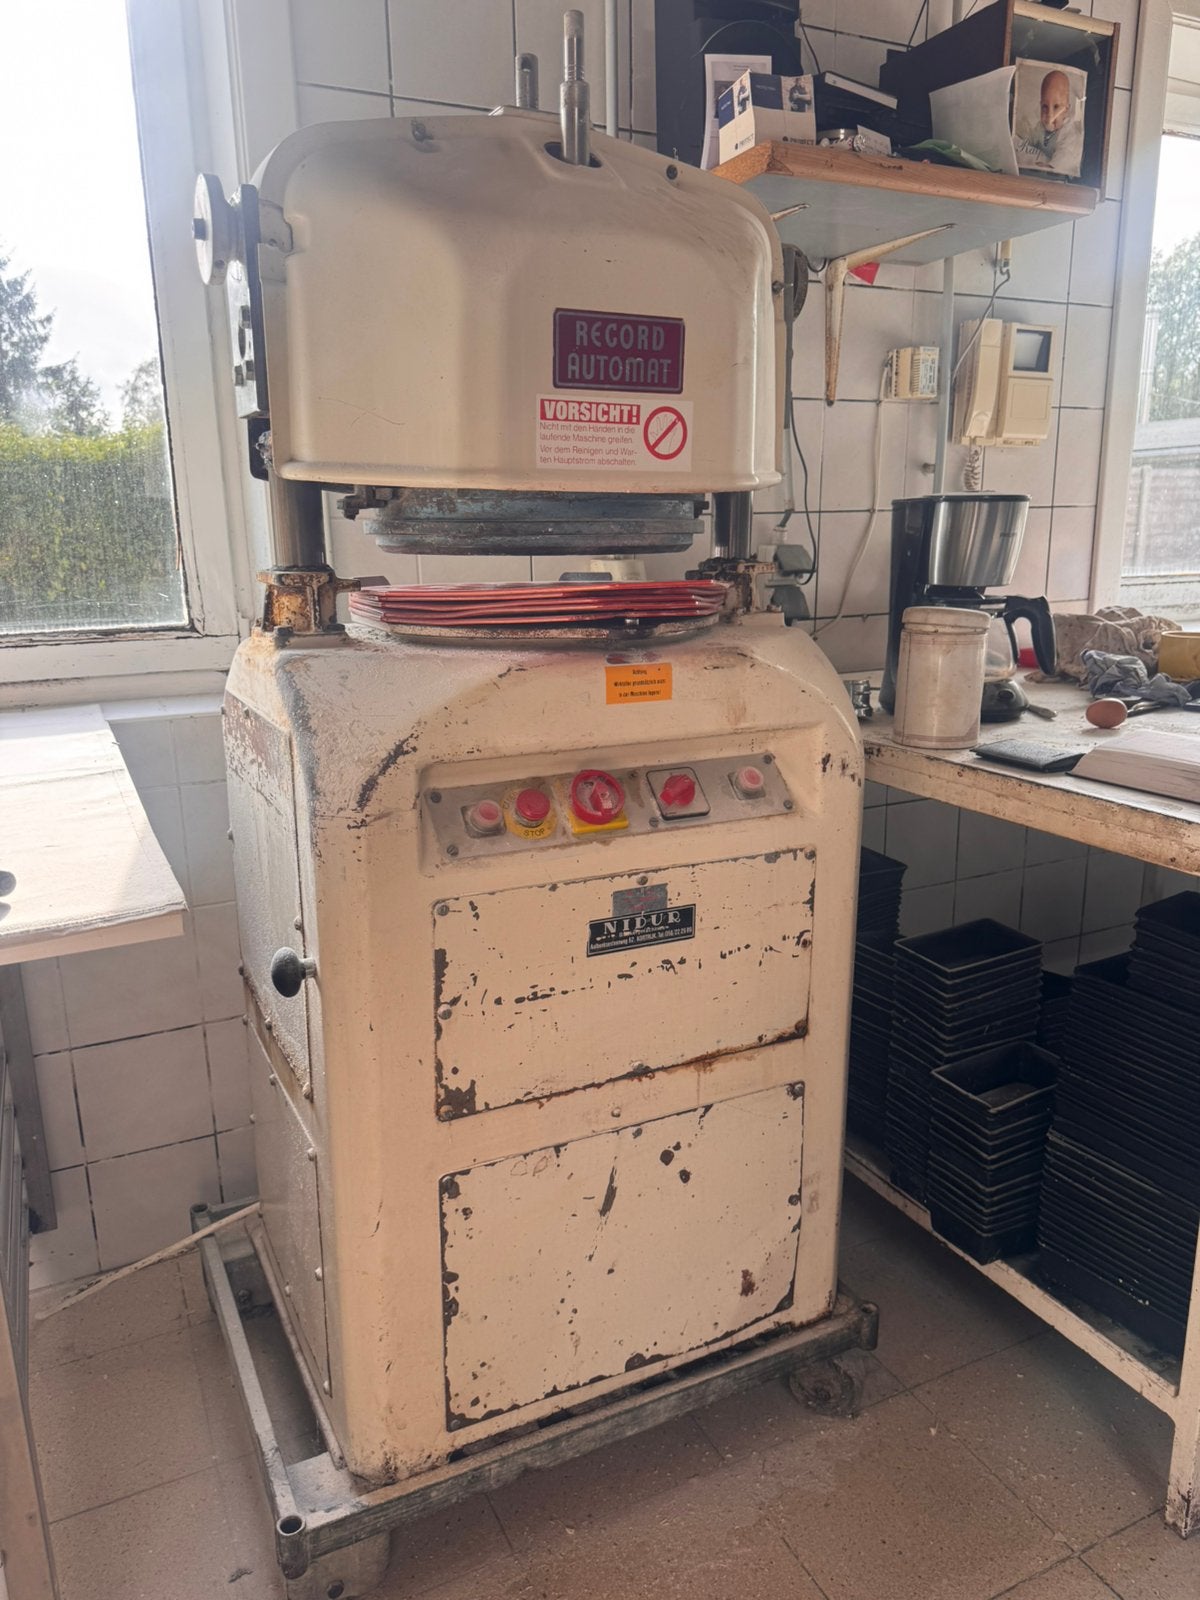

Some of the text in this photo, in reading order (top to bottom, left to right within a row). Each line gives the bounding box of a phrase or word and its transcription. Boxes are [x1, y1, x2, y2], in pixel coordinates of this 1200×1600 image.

[575, 320, 665, 351] RECORD
[567, 353, 671, 384] AUTOMAT
[543, 400, 638, 424] VORSICHT!
[540, 422, 635, 434] Nicht mit den Händen in die
[540, 433, 571, 441] laufende
[572, 434, 606, 443] Maschine
[540, 445, 552, 453] Vor
[554, 445, 571, 453] dem
[572, 446, 603, 456] Reinigen
[605, 447, 618, 455] und
[539, 456, 552, 464] ten
[553, 457, 596, 465] Hauptstrom
[523, 828, 545, 837] STOP
[603, 911, 681, 935] NIDUR
